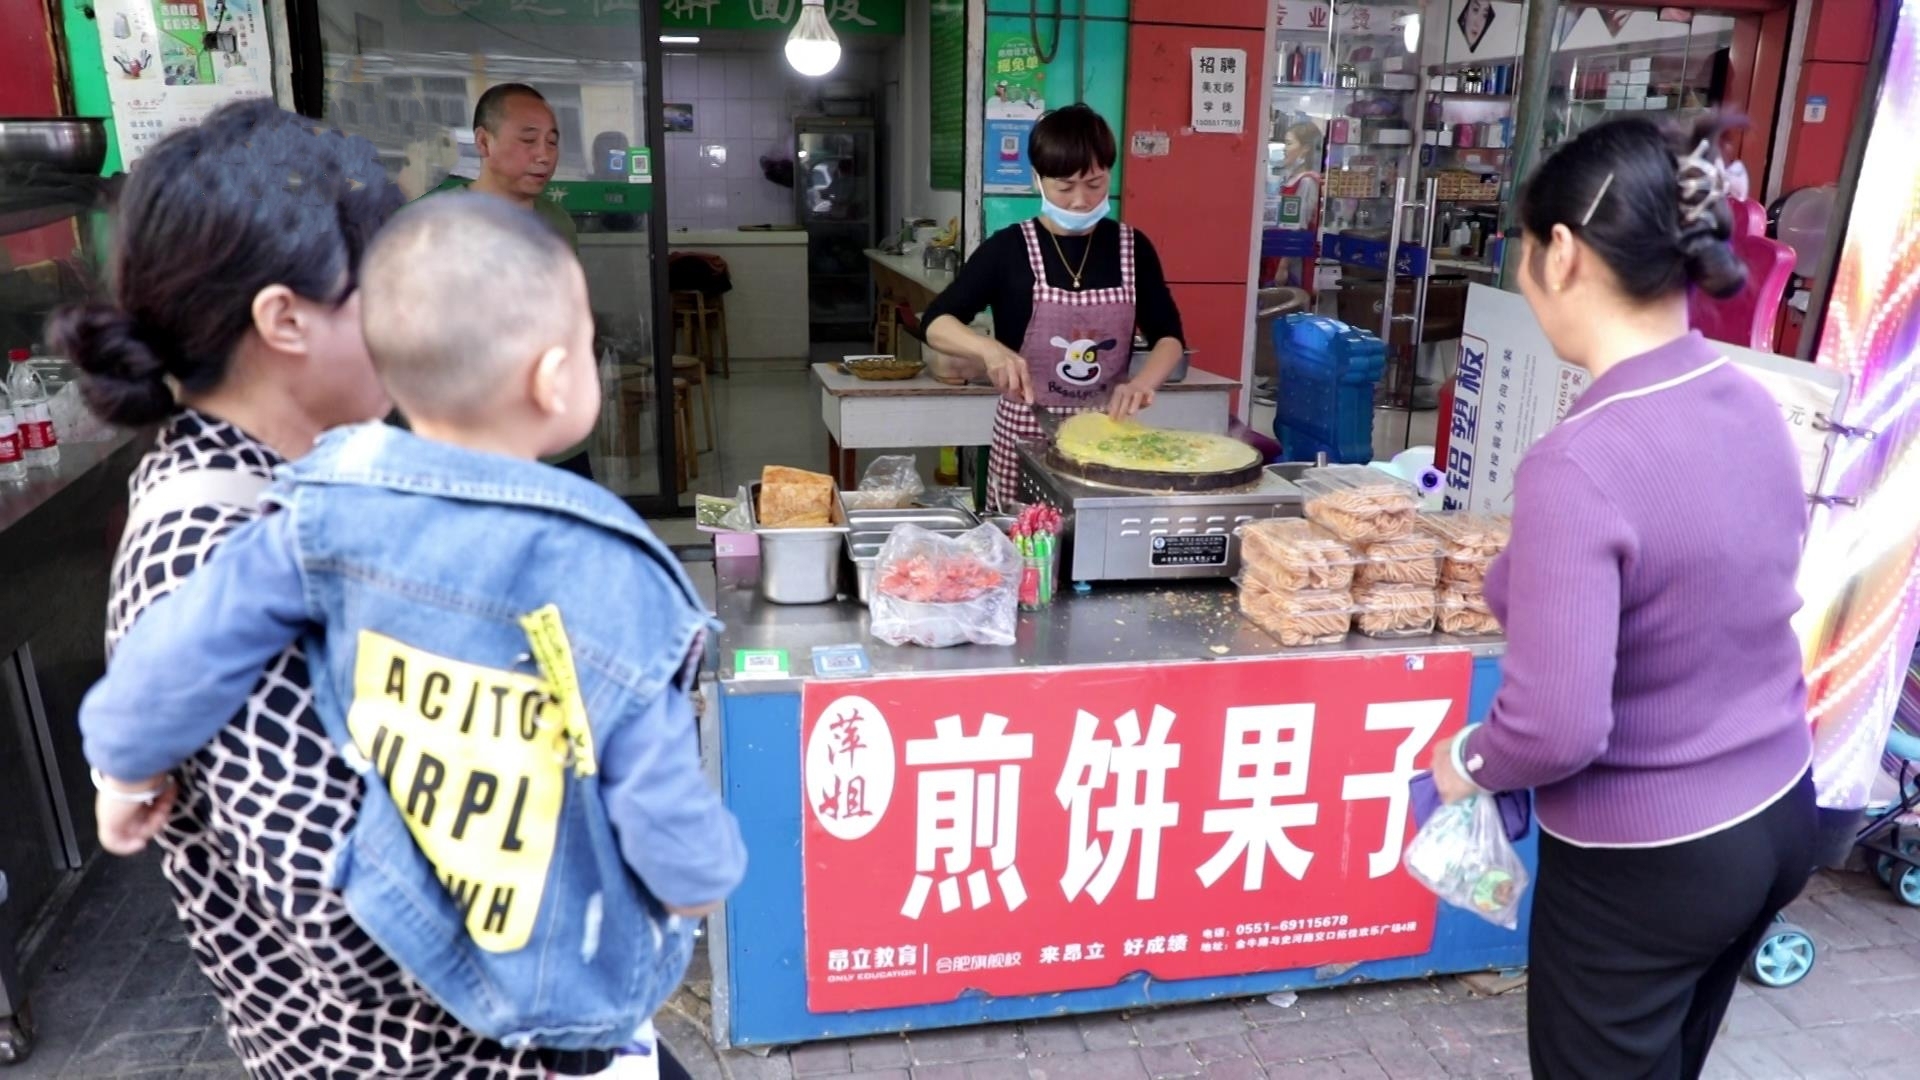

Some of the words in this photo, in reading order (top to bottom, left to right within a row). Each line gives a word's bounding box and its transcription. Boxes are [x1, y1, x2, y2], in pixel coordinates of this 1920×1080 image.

[1200, 56, 1236, 74] 招聘
[818, 708, 873, 821] 萍姐
[900, 698, 1453, 920] 煎饼果子
[828, 944, 917, 972] 昂立教育
[1039, 942, 1106, 965] 来昂立
[1123, 933, 1189, 957] 好成绩
[857, 969, 917, 981] EDUCATION
